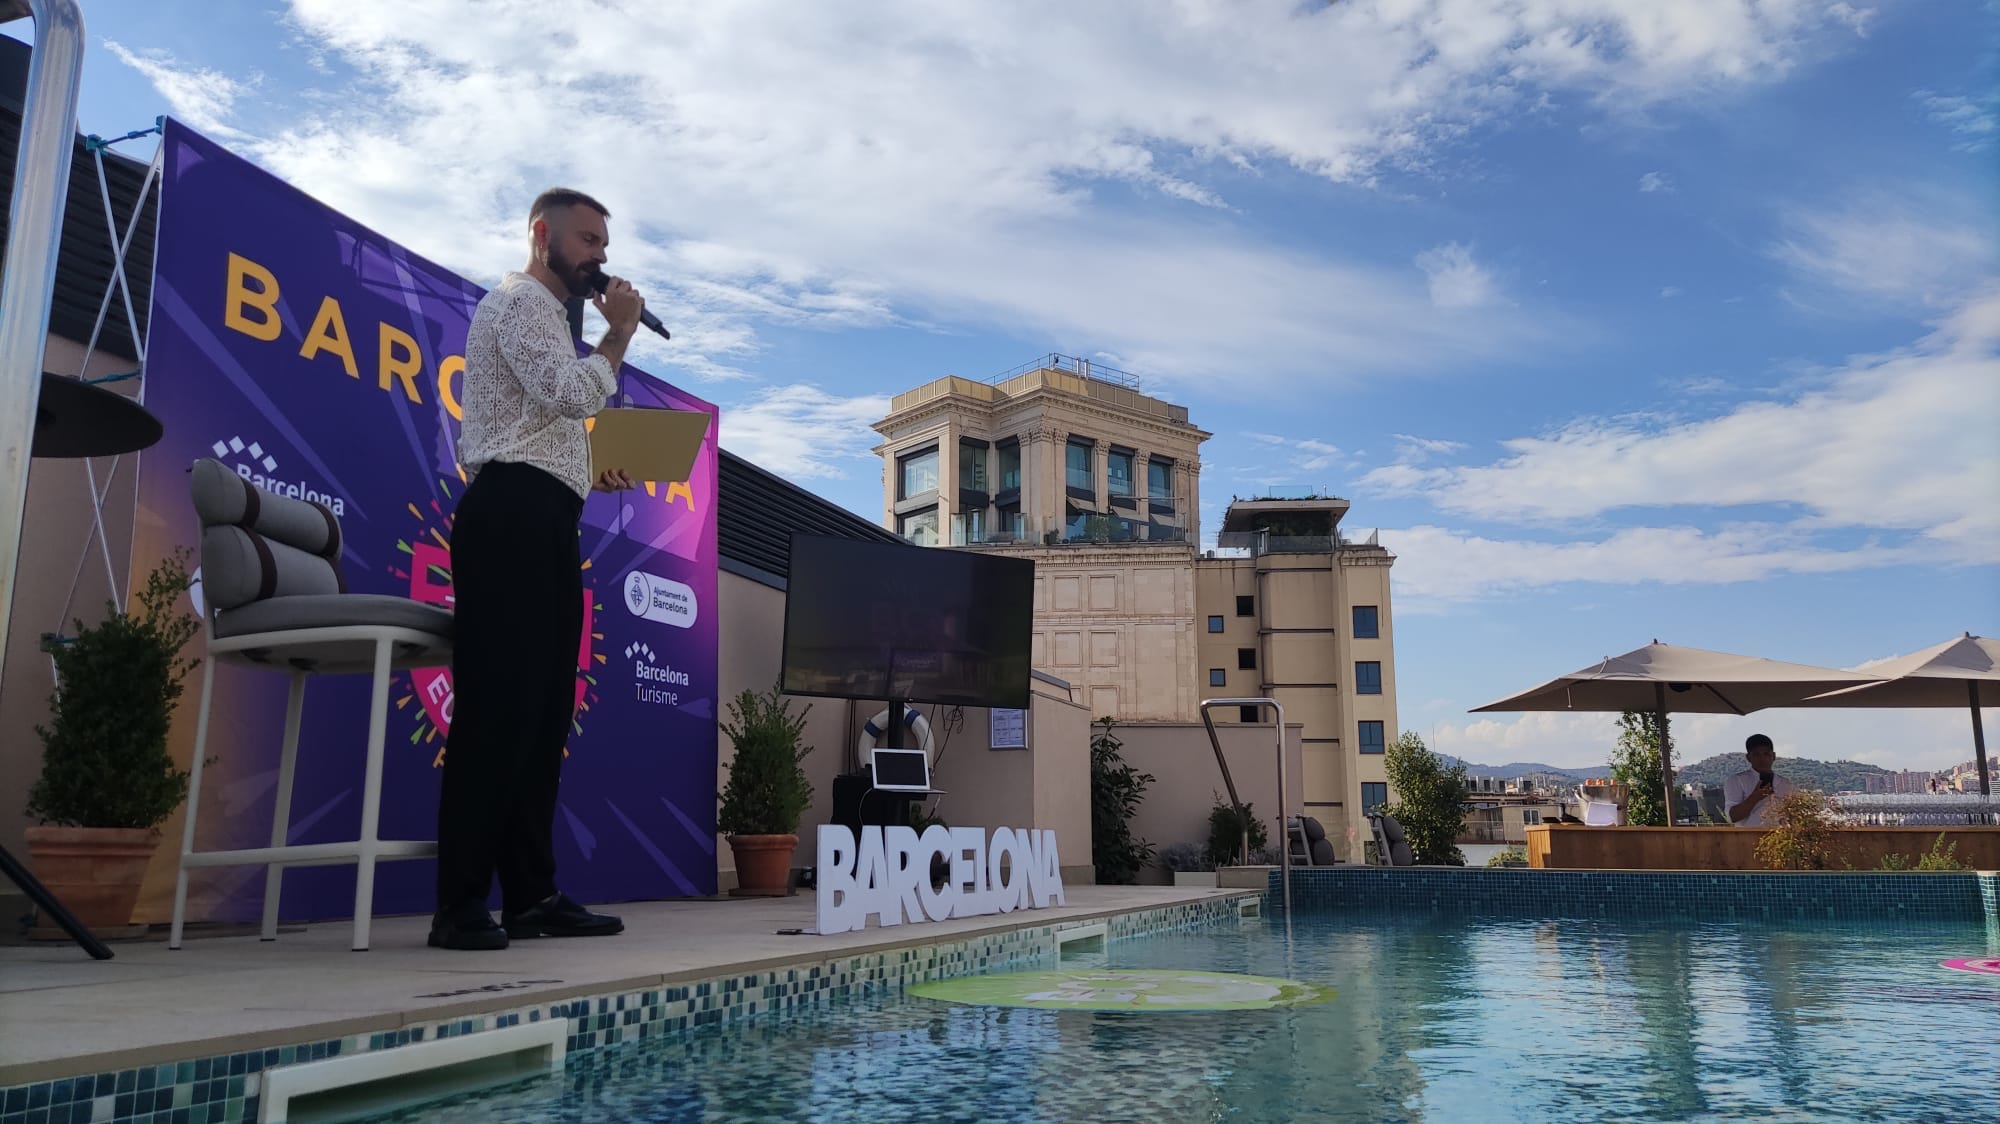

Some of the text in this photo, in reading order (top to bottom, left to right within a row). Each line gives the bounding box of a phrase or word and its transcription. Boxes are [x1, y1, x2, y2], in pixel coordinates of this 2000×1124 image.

[653, 586, 680, 602] Ajuntament
[653, 597, 688, 615] Barcelona
[636, 660, 689, 686] Barcelona
[635, 683, 678, 706] Turisme
[817, 824, 1065, 935] BARCELONA
